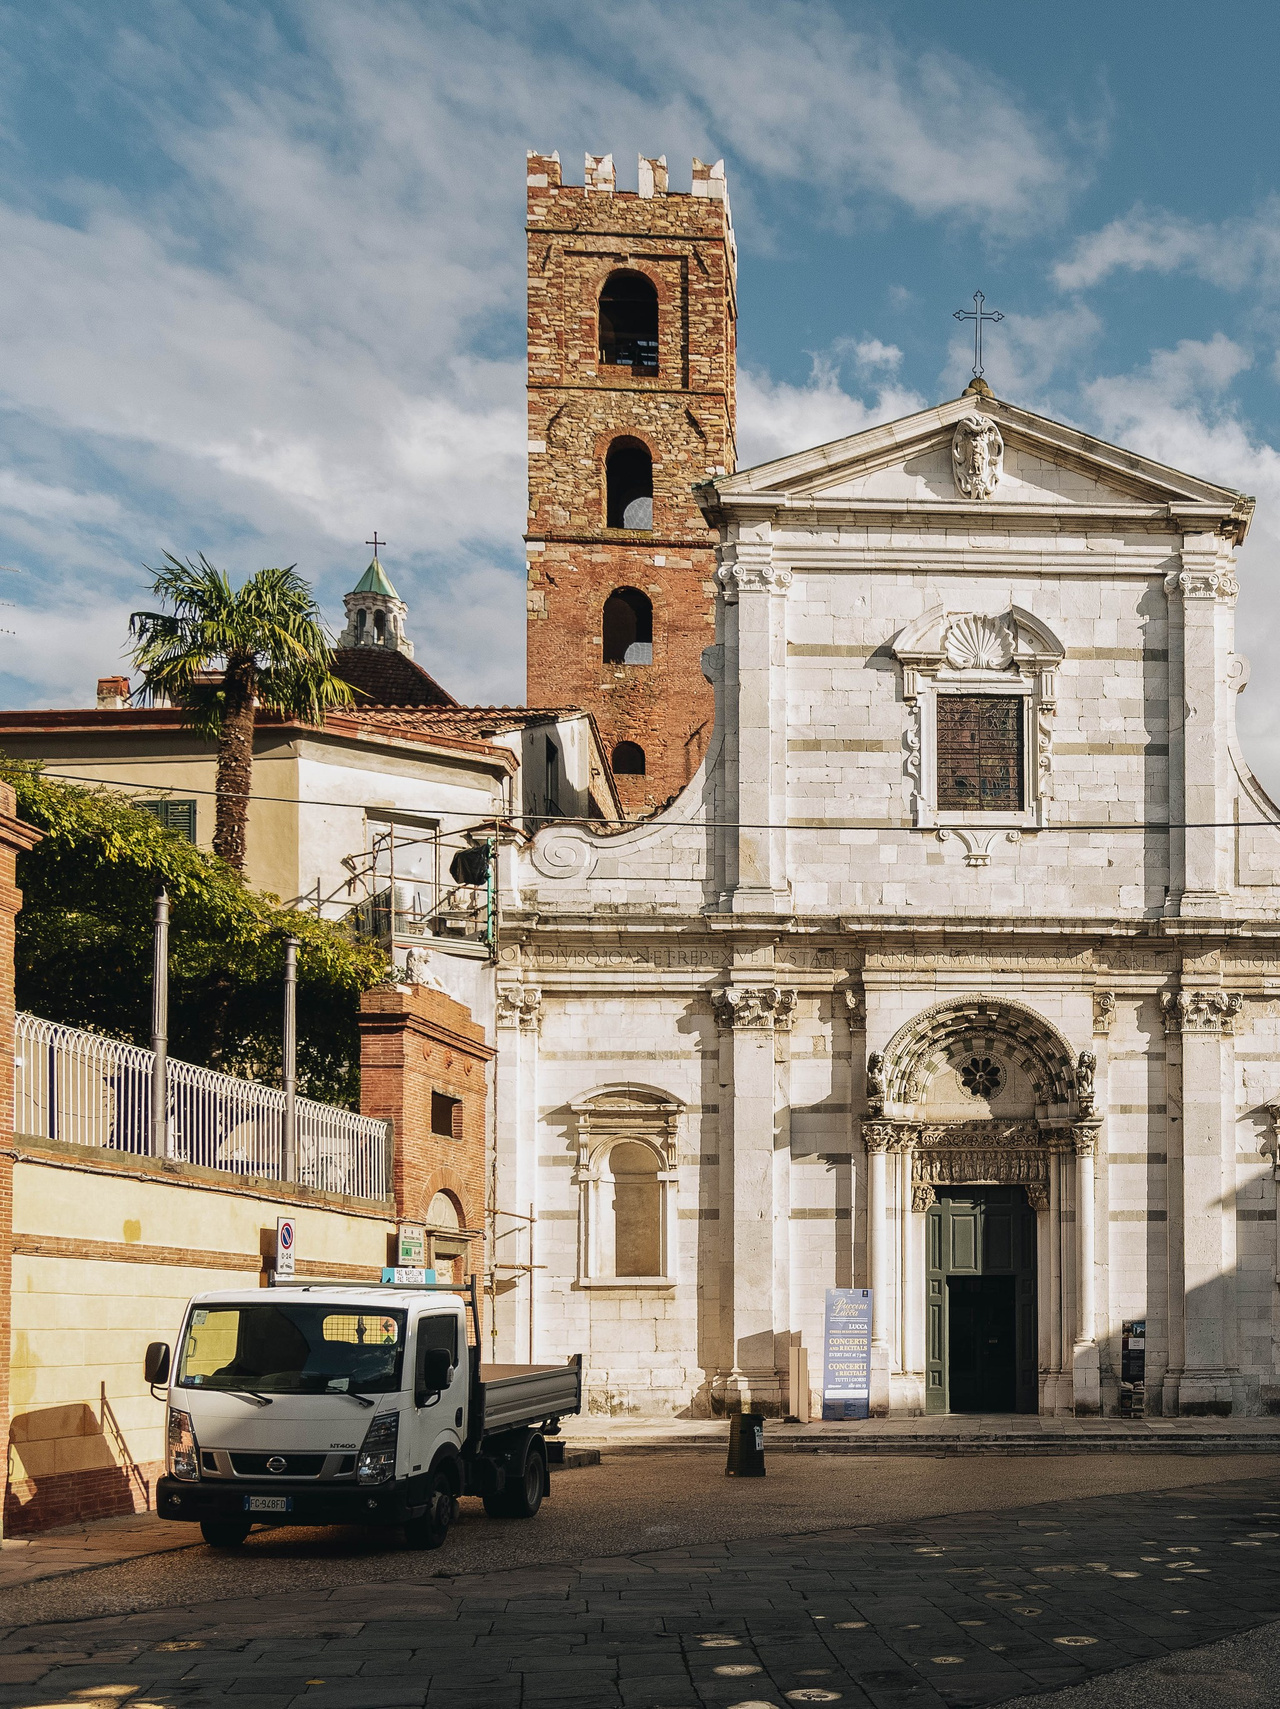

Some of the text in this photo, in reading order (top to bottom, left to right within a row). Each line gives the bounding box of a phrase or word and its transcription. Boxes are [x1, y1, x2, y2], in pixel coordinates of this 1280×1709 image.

[832, 1297, 869, 1310] Puccini
[830, 1308, 859, 1317] Lucca
[828, 1362, 867, 1370] CONCERTI
